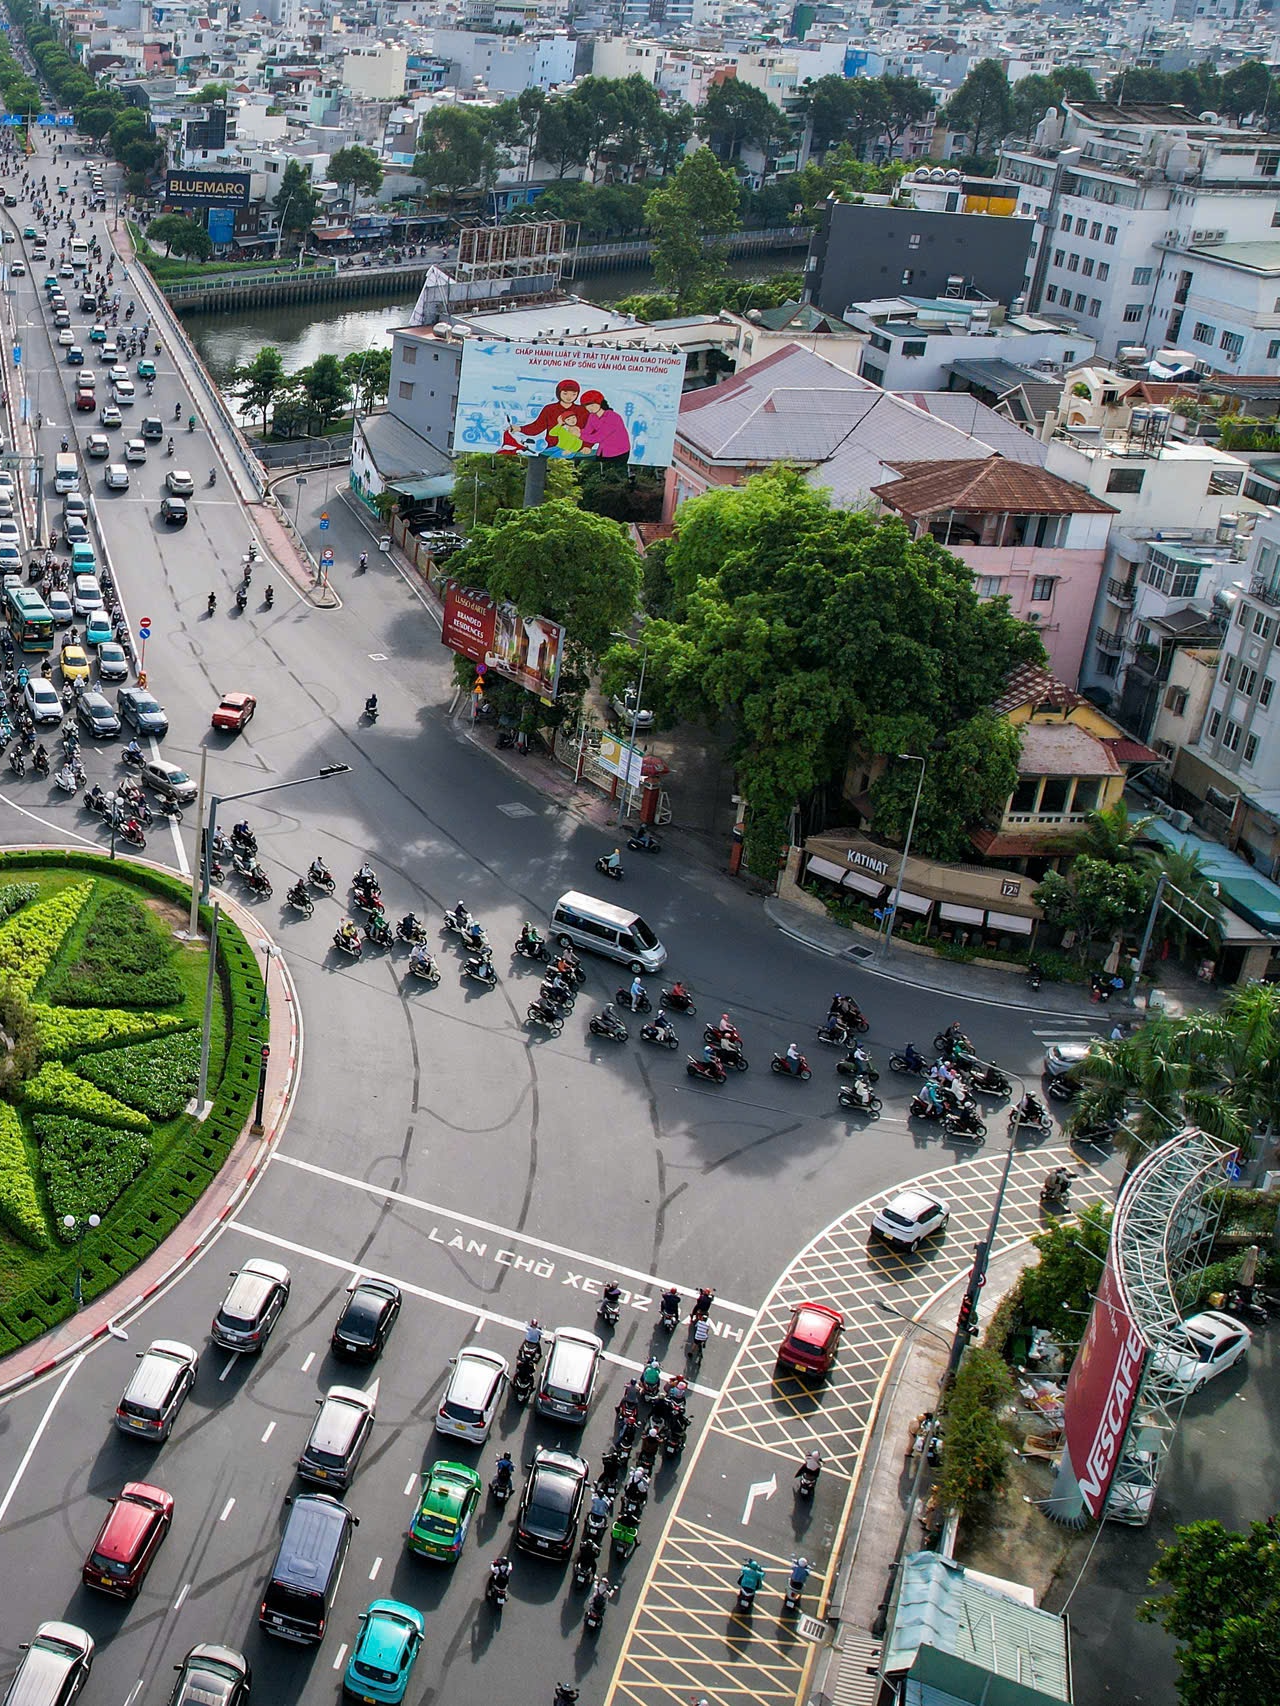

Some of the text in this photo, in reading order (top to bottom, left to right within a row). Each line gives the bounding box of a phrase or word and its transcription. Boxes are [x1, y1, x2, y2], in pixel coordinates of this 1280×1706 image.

[170, 180, 245, 195] BLUEMARQ
[453, 618, 484, 639] RESIDENCES
[456, 610, 482, 628] BRANDED
[847, 849, 889, 876] KATINAT
[427, 1226, 488, 1258] LÀN
[493, 1248, 556, 1280] CHỜ
[562, 1270, 604, 1296] XE
